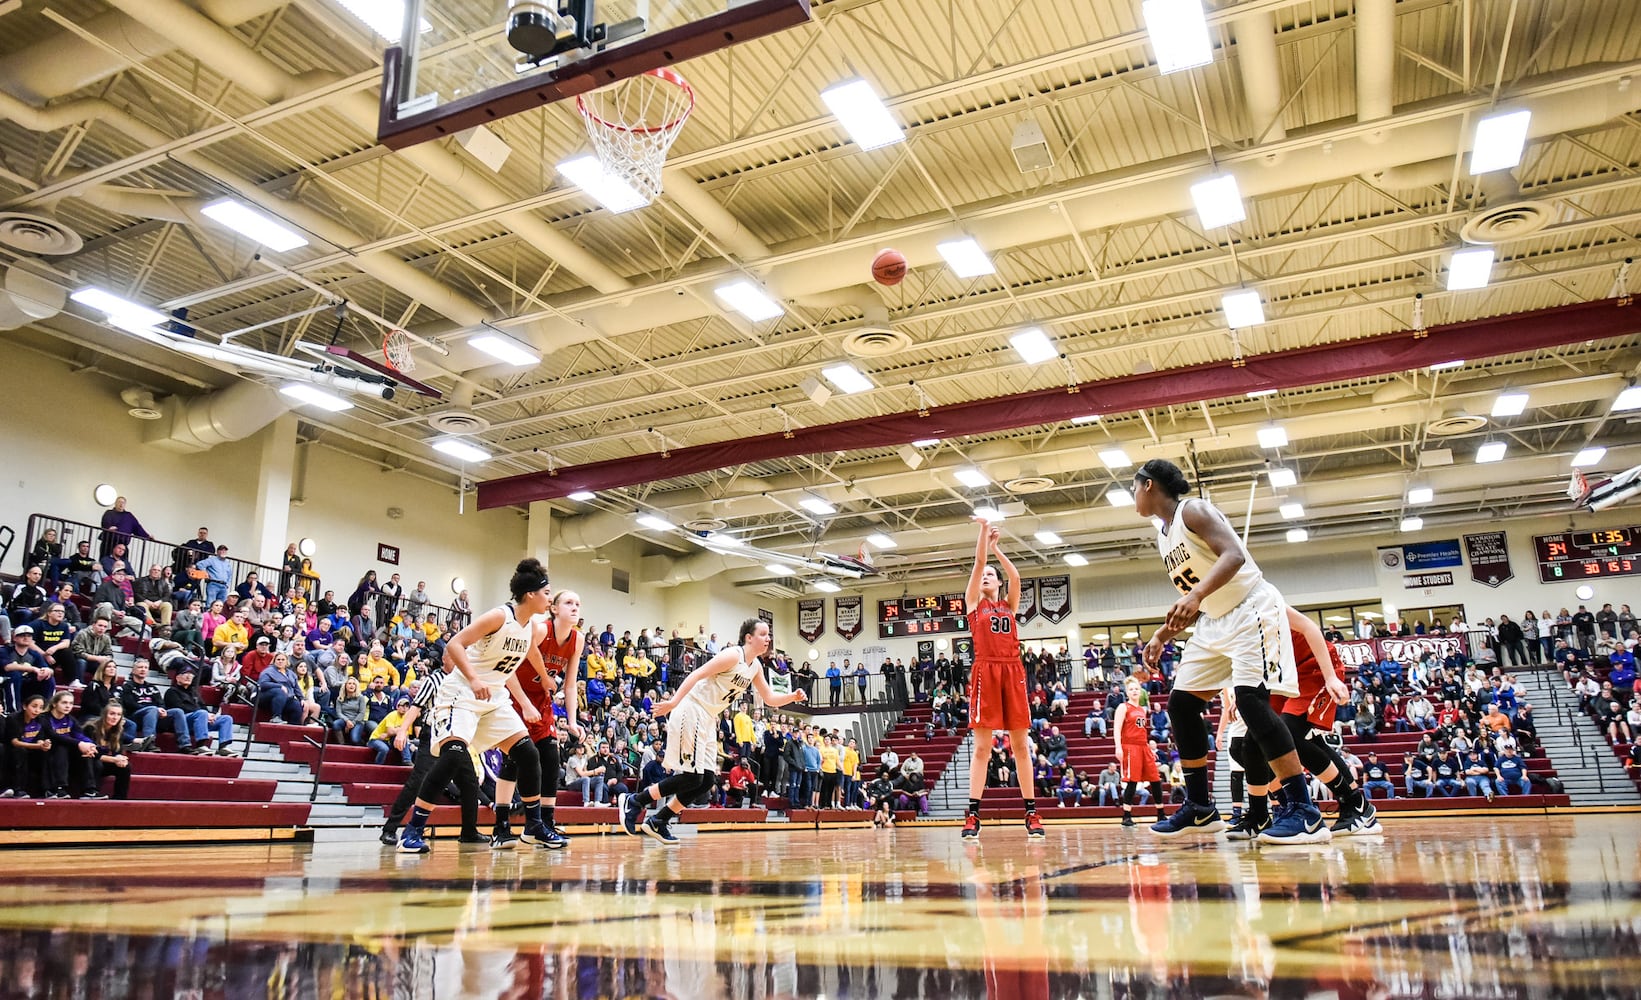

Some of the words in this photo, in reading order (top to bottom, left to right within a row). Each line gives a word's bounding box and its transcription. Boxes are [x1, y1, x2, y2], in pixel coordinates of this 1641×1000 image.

[1543, 535, 1564, 543] HOME
[1592, 530, 1623, 544] 1:35
[1440, 549, 1459, 557] Health
[1471, 548, 1505, 557] CHAMPIONS
[1548, 543, 1567, 555] 34
[1609, 546, 1617, 555] 4
[1584, 563, 1600, 574] 30
[1608, 562, 1620, 572] 15
[1622, 560, 1632, 571] 3
[1554, 567, 1563, 577] 8
[1173, 567, 1200, 595] 35
[1423, 574, 1451, 584] STUDENTS
[916, 597, 937, 608] 1:35
[950, 600, 963, 611] 39
[886, 606, 898, 616] 34
[958, 620, 964, 628] 8
[989, 615, 1012, 634] 30
[887, 626, 894, 634] 8
[1337, 643, 1376, 668] AR
[493, 656, 520, 674] 22
[1135, 717, 1146, 728] 40
